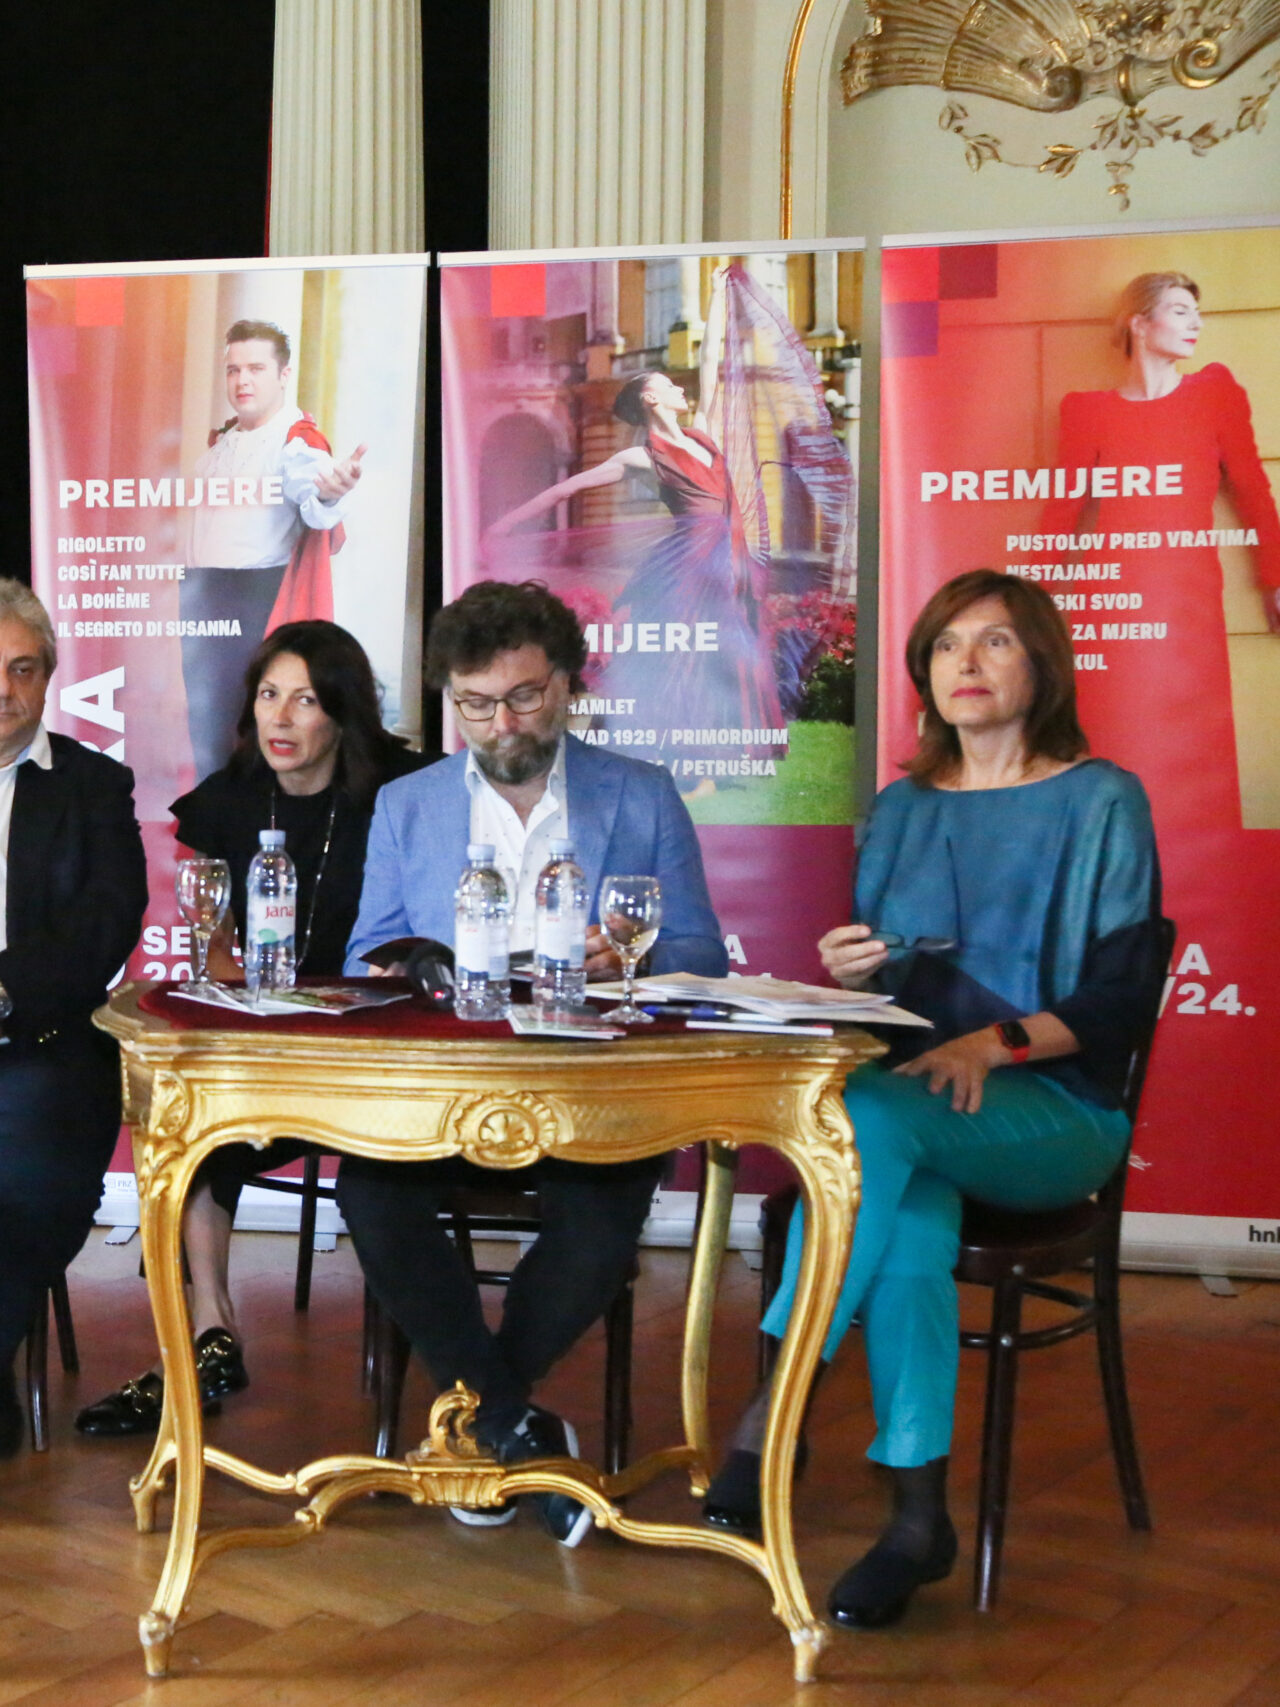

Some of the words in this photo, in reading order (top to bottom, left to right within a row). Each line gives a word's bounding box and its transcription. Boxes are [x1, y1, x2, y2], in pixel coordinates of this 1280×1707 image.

[58, 475, 284, 509] PREMIJERE
[921, 464, 1184, 503] PREMIJERE
[57, 536, 146, 553] RIGOLETTO
[1006, 533, 1106, 553] PUSTOLOV
[1109, 531, 1162, 550] PRED
[1166, 529, 1260, 548] VRATIMA
[57, 558, 97, 582] COSÌ
[99, 564, 132, 581] FAN
[134, 563, 186, 580] TUTTE
[57, 593, 78, 610] LA
[81, 586, 151, 609] BOHÈME
[1051, 593, 1087, 611] SKI
[1090, 592, 1144, 611] SVOD
[57, 622, 72, 638] IL
[75, 621, 144, 637] SEGRETO
[146, 620, 163, 637] DI
[165, 619, 243, 637] SUSANNA
[1071, 623, 1098, 641] ZA
[1101, 622, 1168, 640] MJERU
[612, 729, 657, 746] 1929
[671, 728, 789, 745] PRIMORDIUM
[682, 753, 777, 777] PETRUŠKA
